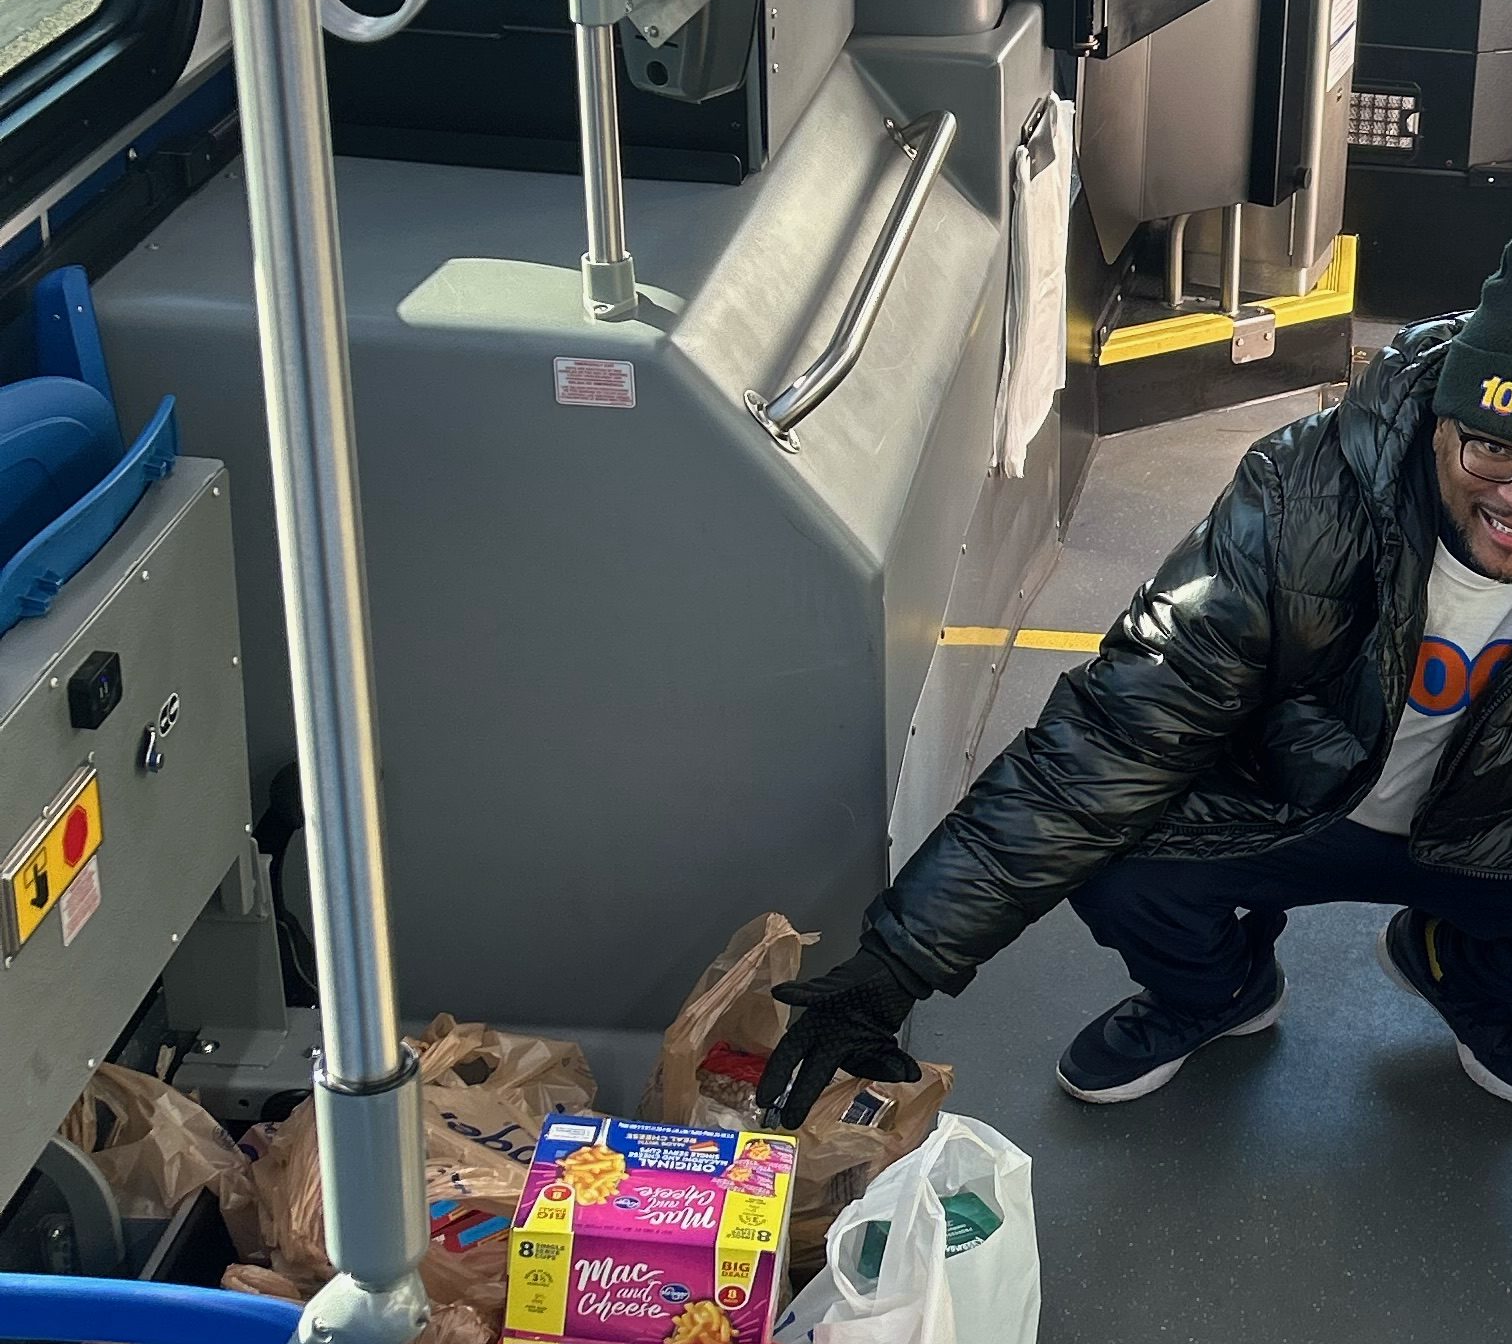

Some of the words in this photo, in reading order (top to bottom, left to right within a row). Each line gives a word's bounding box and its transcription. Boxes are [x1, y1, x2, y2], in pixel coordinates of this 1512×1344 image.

[640, 1158, 716, 1173] ORIGINAL
[635, 1207, 716, 1229] Mac
[518, 1240, 534, 1258] 8
[574, 1257, 664, 1292] Mac
[721, 1260, 750, 1272] BIG
[616, 1280, 662, 1301] and
[578, 1292, 670, 1323] Cheese
